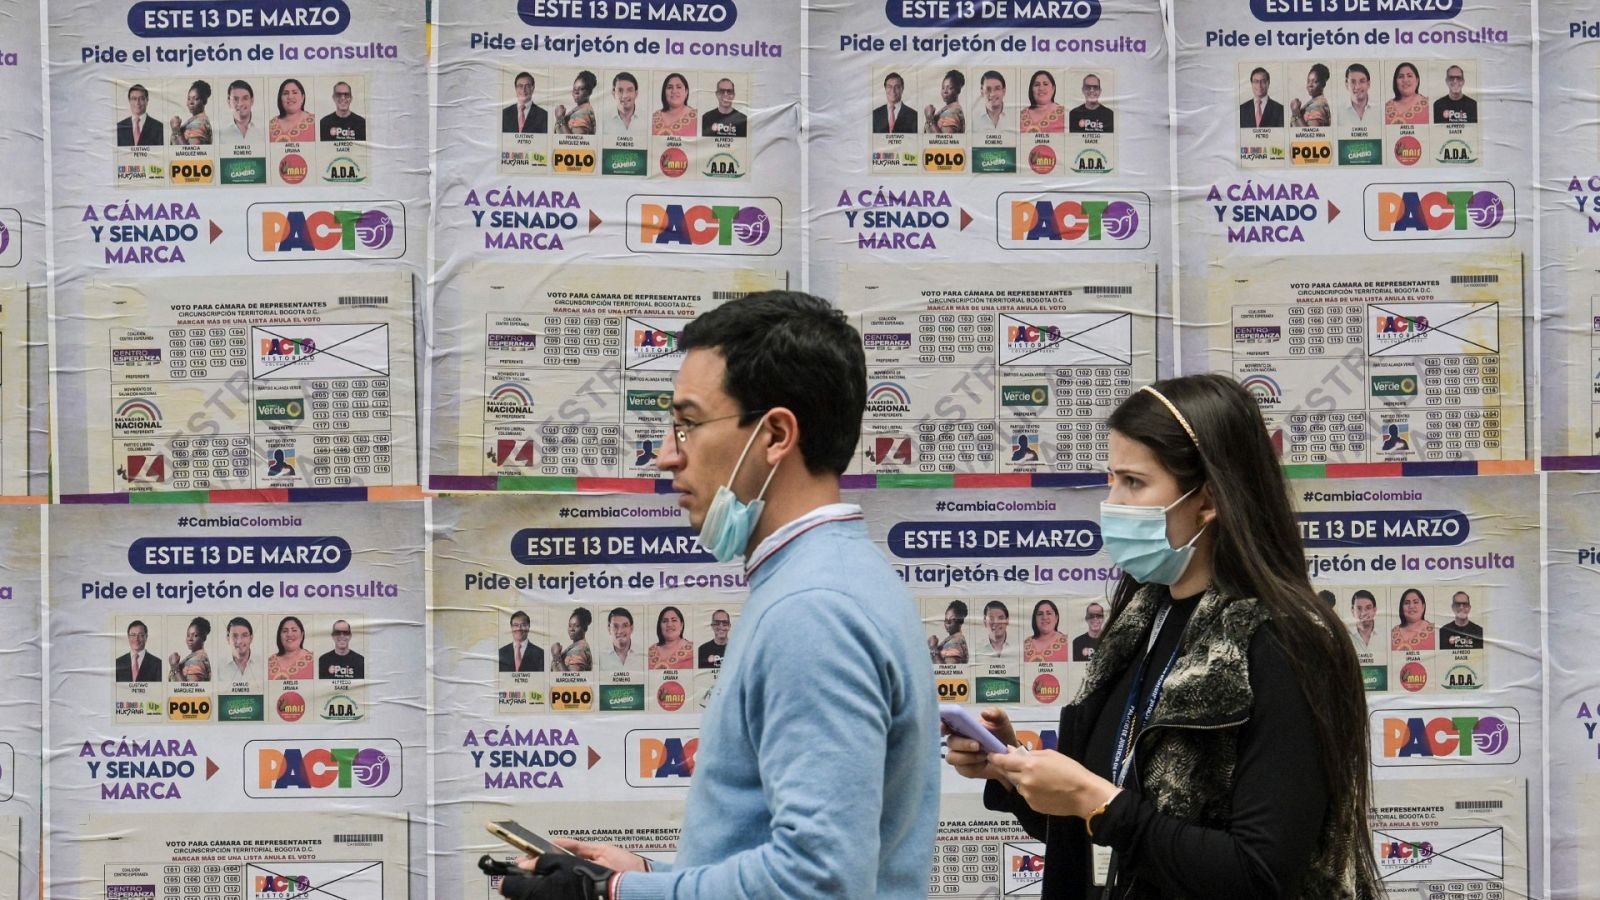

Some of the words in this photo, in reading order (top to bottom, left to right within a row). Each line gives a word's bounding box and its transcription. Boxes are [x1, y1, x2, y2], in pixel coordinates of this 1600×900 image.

[534, 0, 584, 18] ESTE
[590, 1, 607, 20] 13
[615, 1, 640, 21] DE
[649, 2, 727, 23] MARZO
[902, 0, 951, 18] ESTE
[957, 1, 975, 18] 13
[982, 1, 1007, 18] DE
[1014, 0, 1091, 17] MARZO
[1266, 0, 1313, 13] ESTE
[1320, 0, 1337, 13] 13
[1343, 0, 1370, 13] DE
[144, 9, 194, 28] ESTE
[200, 9, 218, 28] 13
[227, 9, 253, 27] DE
[262, 7, 339, 26] MARZO
[1570, 21, 1600, 38] Pid
[471, 32, 518, 50] Pide
[521, 33, 539, 50] el
[543, 34, 628, 57] tarjetón
[634, 37, 660, 53] de
[666, 38, 685, 55] la
[689, 40, 782, 57] consulta
[841, 35, 884, 51] Pide
[890, 34, 907, 51] el
[913, 33, 995, 57] tarjetón
[1000, 35, 1026, 51] de
[1032, 35, 1049, 51] la
[1054, 35, 1146, 53] consulta
[1206, 30, 1249, 47] Pide
[1255, 30, 1272, 46] el
[1277, 28, 1359, 51] tarjetón
[1364, 28, 1390, 44] de
[1395, 28, 1413, 44] la
[1417, 27, 1508, 44] consulta
[82, 46, 127, 63] Pide
[133, 46, 150, 62] el
[156, 43, 242, 67] tarjetón
[248, 44, 274, 60] de
[279, 45, 298, 60] la
[304, 43, 398, 60] consulta
[555, 154, 593, 167] POLO
[925, 154, 963, 165] POLO
[1292, 146, 1330, 159] POLO
[171, 164, 212, 178] POLO
[1207, 185, 1222, 201] A
[1227, 180, 1318, 201] CÁMARA
[1568, 176, 1583, 191] A
[465, 190, 480, 206] A
[485, 186, 580, 208] CÁMARA
[837, 191, 852, 207] A
[858, 185, 952, 208] CÁMARA
[1575, 196, 1588, 212] Y
[83, 206, 97, 220] A
[103, 200, 200, 222] CÁMARA
[845, 212, 857, 227] Y
[863, 211, 949, 228] SENADO
[1215, 206, 1227, 222] Y
[1233, 204, 1317, 222] SENADO
[473, 211, 484, 227] Y
[491, 211, 577, 229] SENADO
[91, 226, 102, 243] Y
[110, 224, 198, 242] SENADO
[485, 233, 563, 249] MARCA
[859, 232, 936, 249] MARCA
[1228, 226, 1304, 243] MARCA
[105, 247, 185, 265] MARCA
[1374, 382, 1399, 391] Verde
[1004, 392, 1030, 400] Verde
[258, 406, 285, 414] Verde
[1304, 491, 1422, 502] #CambiaColombia
[560, 506, 682, 519] #CambiaColombia
[936, 501, 1056, 512] #CambiaColombia
[177, 516, 302, 528] #CambiaColombia
[1297, 521, 1319, 538] TE
[1326, 520, 1344, 538] 13
[1351, 520, 1376, 538] DE
[1383, 519, 1460, 537] MARZO
[528, 538, 576, 556] ESTE
[582, 538, 601, 555] 13
[608, 538, 635, 555] DE
[642, 536, 713, 554] MARZ
[904, 531, 952, 549] ESTE
[958, 531, 977, 548] 13
[984, 531, 1010, 548] DE
[1017, 529, 1094, 548] MARZO
[145, 546, 194, 565] ESTE
[200, 546, 219, 564] 13
[228, 546, 254, 564] DE
[261, 546, 341, 564] MARZO
[1307, 554, 1365, 577] rjetón
[1371, 555, 1396, 570] de
[1402, 555, 1420, 570] la
[1425, 553, 1514, 570] consulta
[465, 573, 510, 590] Pide
[515, 573, 532, 589] el
[538, 571, 623, 594] tarjetón
[629, 572, 654, 588] de
[660, 571, 678, 588] la
[684, 574, 748, 587] consu
[915, 564, 998, 587] tarjetón
[1004, 565, 1029, 581] de
[1035, 565, 1053, 581] la
[1058, 568, 1120, 580] consu
[82, 583, 128, 600] Pide
[132, 582, 150, 599] el
[156, 581, 243, 603] tarjetón
[248, 581, 273, 597] de
[279, 581, 298, 597] la
[304, 581, 398, 598] consulta
[552, 692, 590, 704] POLO
[169, 702, 209, 714] POLO
[1577, 702, 1592, 718] A
[463, 730, 479, 746] A
[484, 725, 579, 746] CÁMARA
[1584, 723, 1597, 739] Y
[79, 740, 95, 756] A
[101, 735, 198, 757] CÁMARA
[471, 751, 482, 766] Y
[490, 751, 576, 767] SENADO
[88, 762, 100, 778] Y
[107, 761, 195, 779] SENADO
[485, 772, 563, 788] MARCA
[101, 783, 181, 799] MARCA
